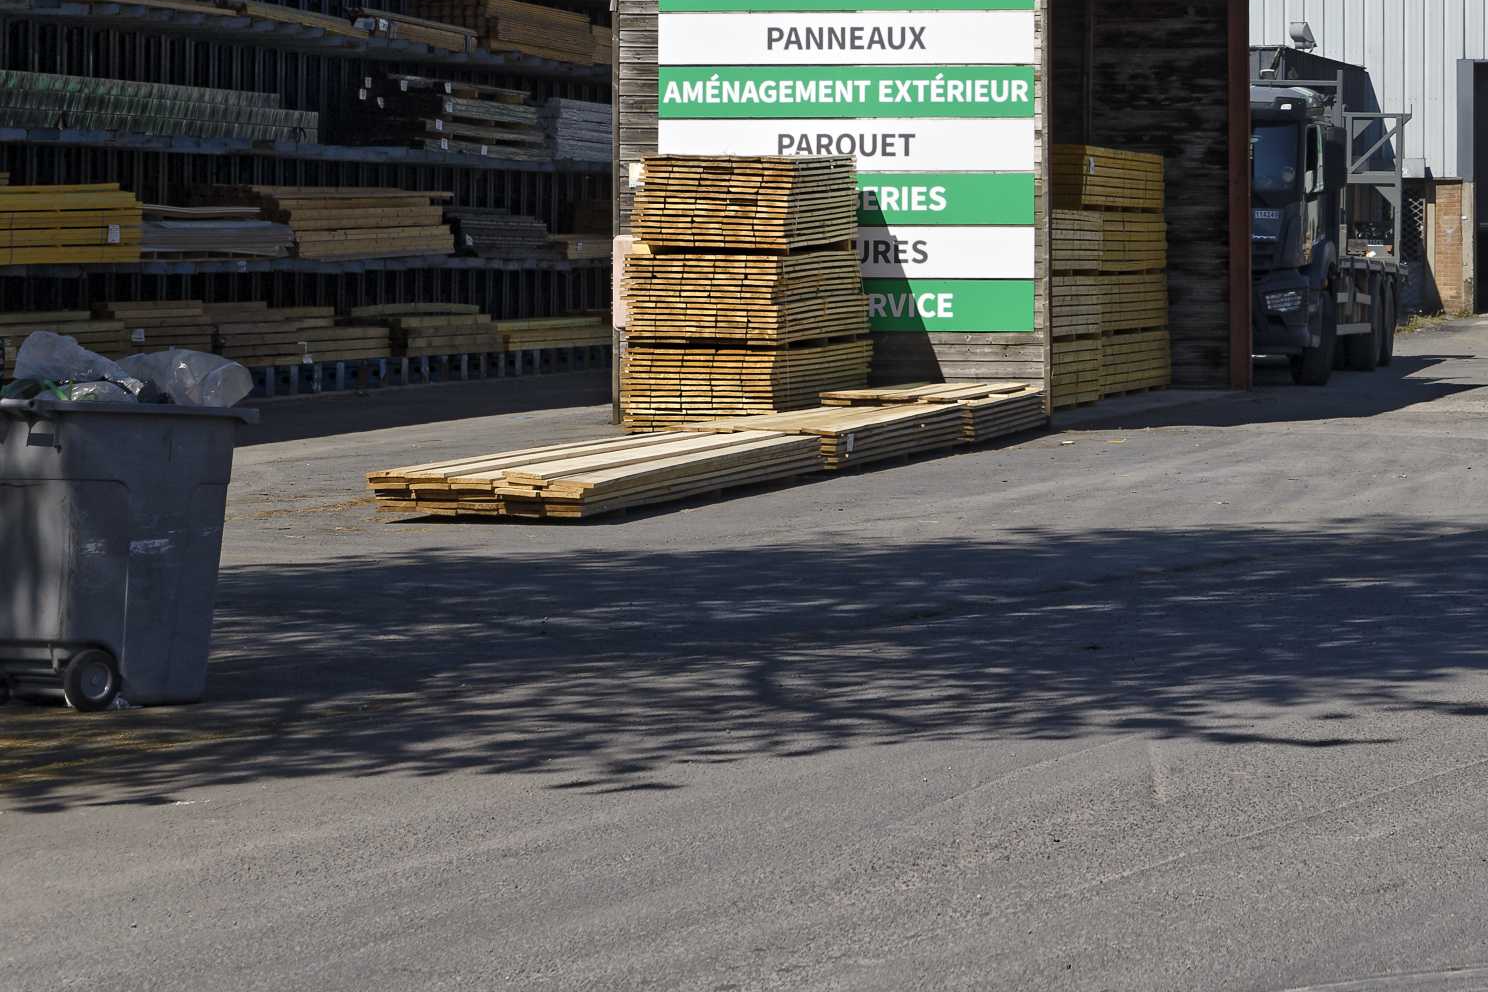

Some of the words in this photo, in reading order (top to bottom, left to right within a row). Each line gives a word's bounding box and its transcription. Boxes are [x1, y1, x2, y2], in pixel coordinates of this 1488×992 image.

[767, 26, 927, 51] PANNEAUX
[663, 73, 872, 104] AMÉNAGEMENT
[878, 72, 1029, 103] EXTÉRIEUR
[777, 133, 916, 157] PARQUET
[855, 185, 947, 212] ERIES
[868, 292, 954, 319] RVICE
